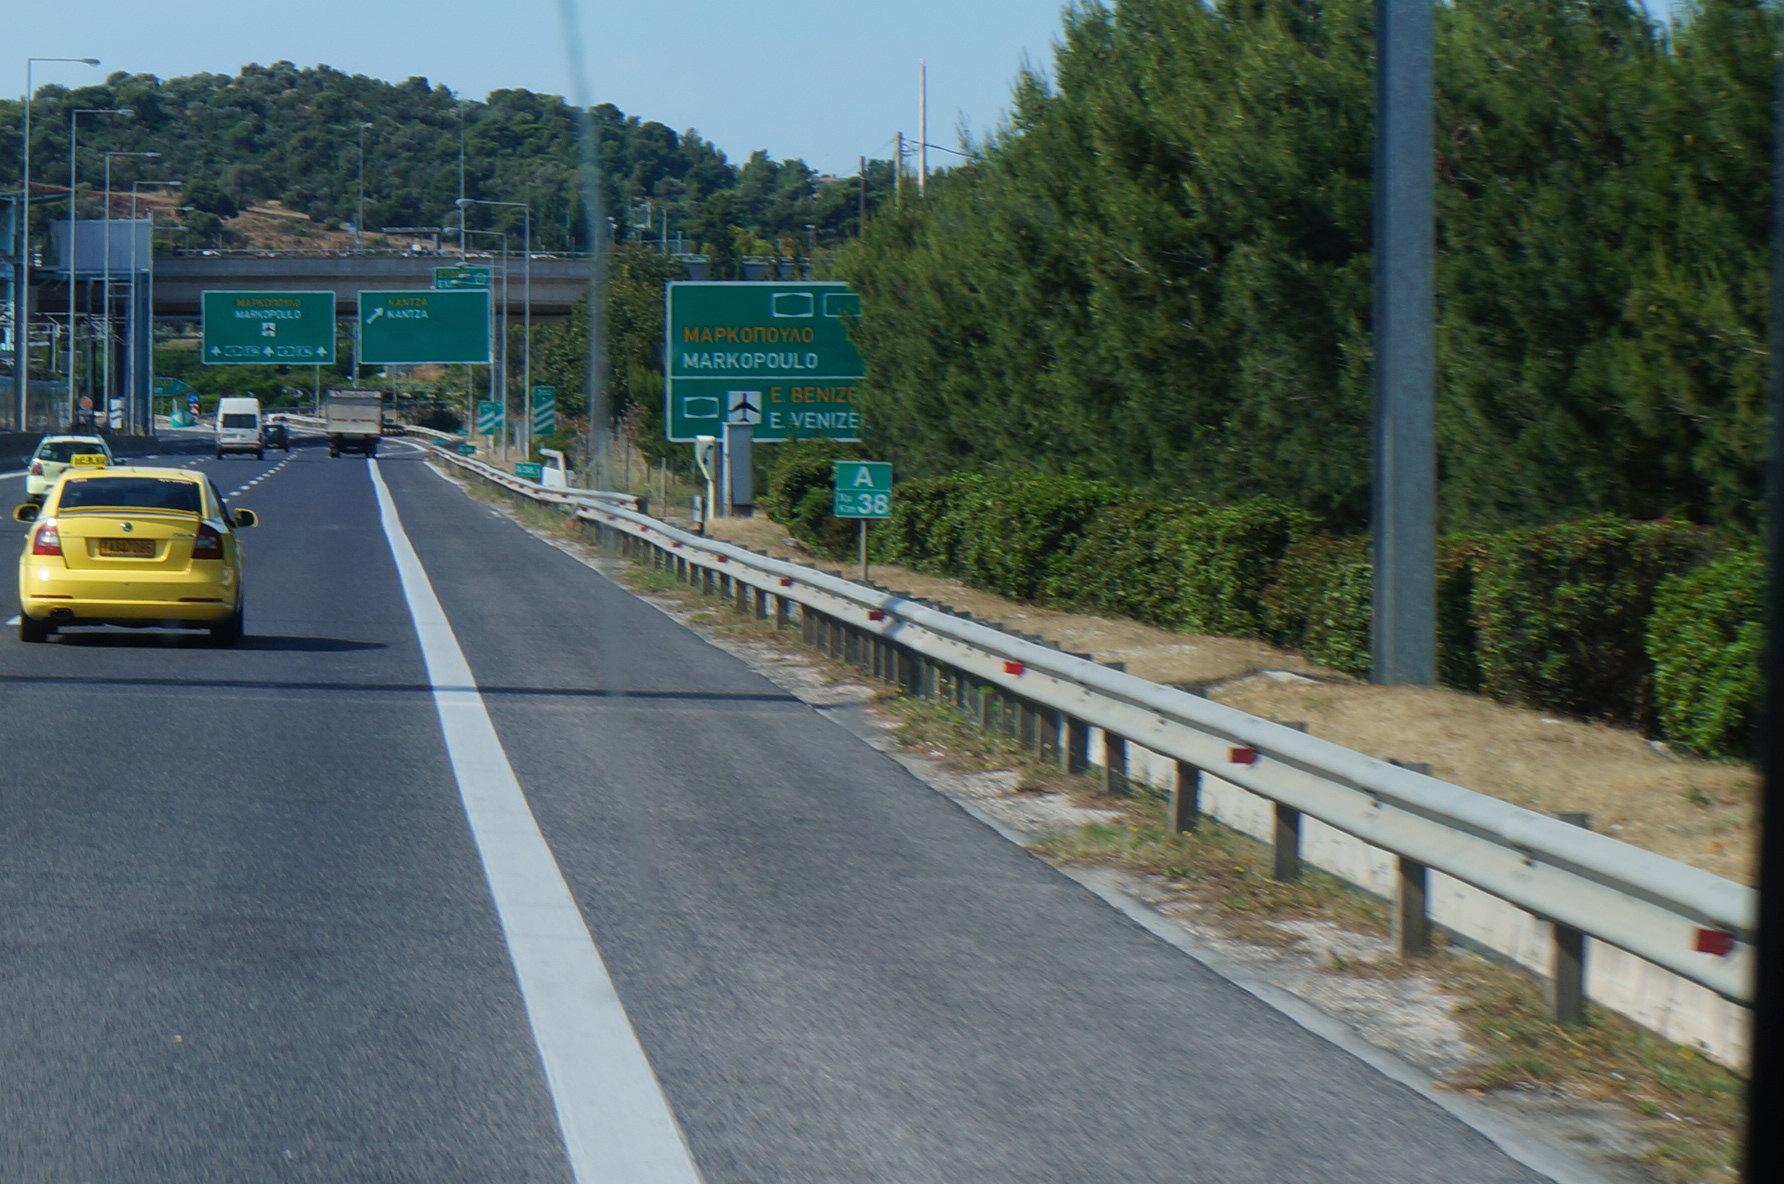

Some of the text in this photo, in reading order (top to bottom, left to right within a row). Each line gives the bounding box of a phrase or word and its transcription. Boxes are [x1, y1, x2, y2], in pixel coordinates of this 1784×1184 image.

[683, 326, 815, 344] ΜΑΡΚΟΠΟΥΛΟ
[683, 352, 819, 369] MARKOPOULO
[856, 493, 889, 515] 38
